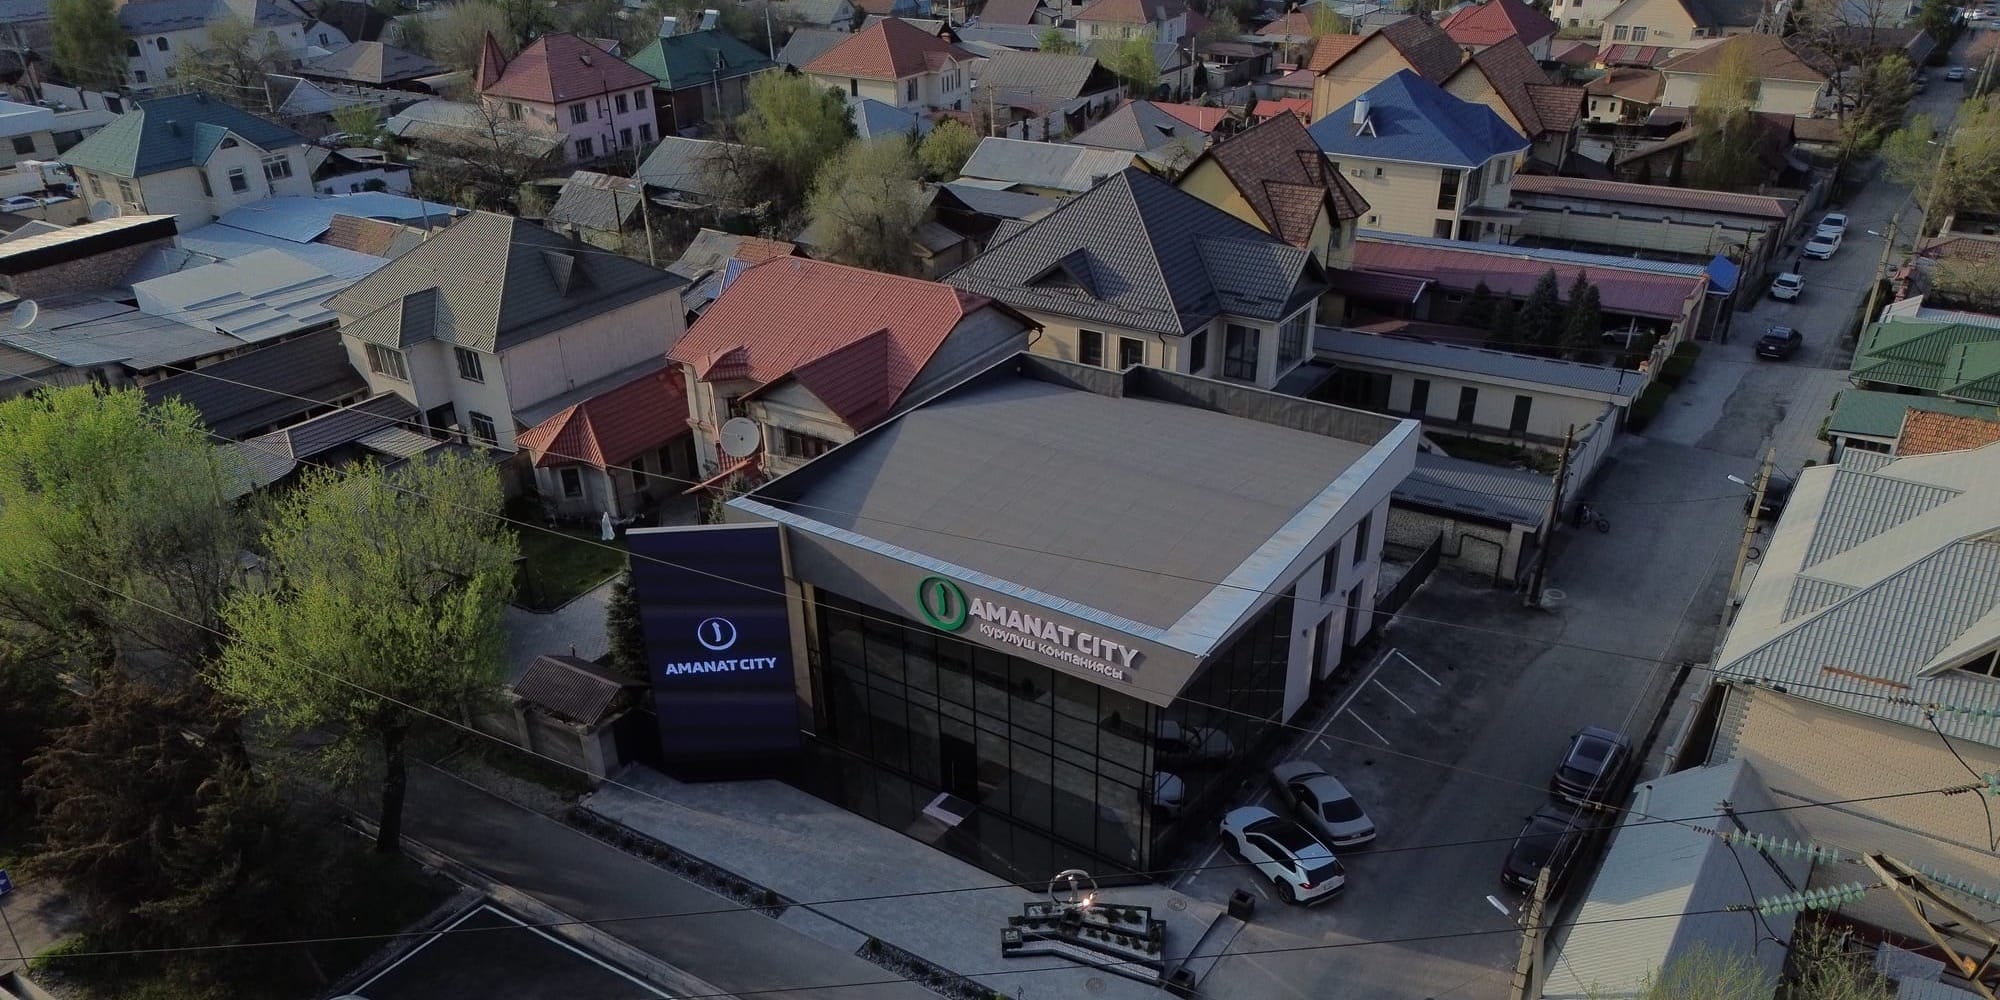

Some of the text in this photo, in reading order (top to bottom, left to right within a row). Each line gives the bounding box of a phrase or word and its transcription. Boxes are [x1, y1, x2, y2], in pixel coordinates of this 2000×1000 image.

[969, 598, 1139, 668] AMANAT CITY
[980, 624, 1123, 680] курулуш компаниясы
[666, 657, 776, 675] AMANAT CITY
